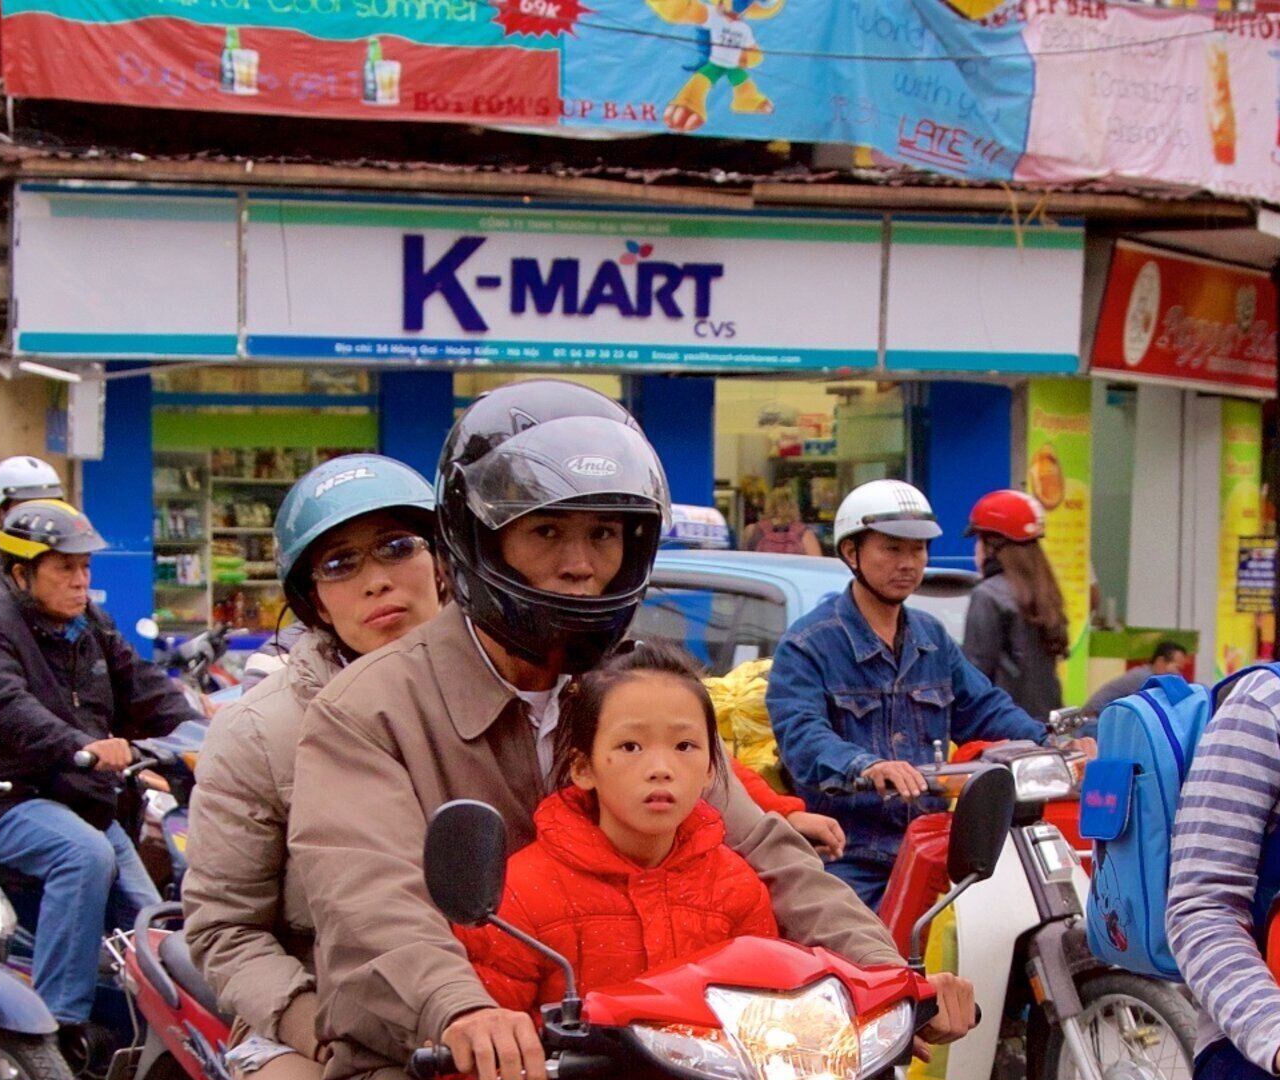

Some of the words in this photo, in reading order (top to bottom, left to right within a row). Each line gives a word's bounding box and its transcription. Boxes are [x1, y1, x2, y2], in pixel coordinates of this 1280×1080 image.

[560, 99, 594, 119] UP
[603, 102, 658, 121] BAR
[402, 233, 725, 333] K-MART
[693, 319, 737, 339] CVS
